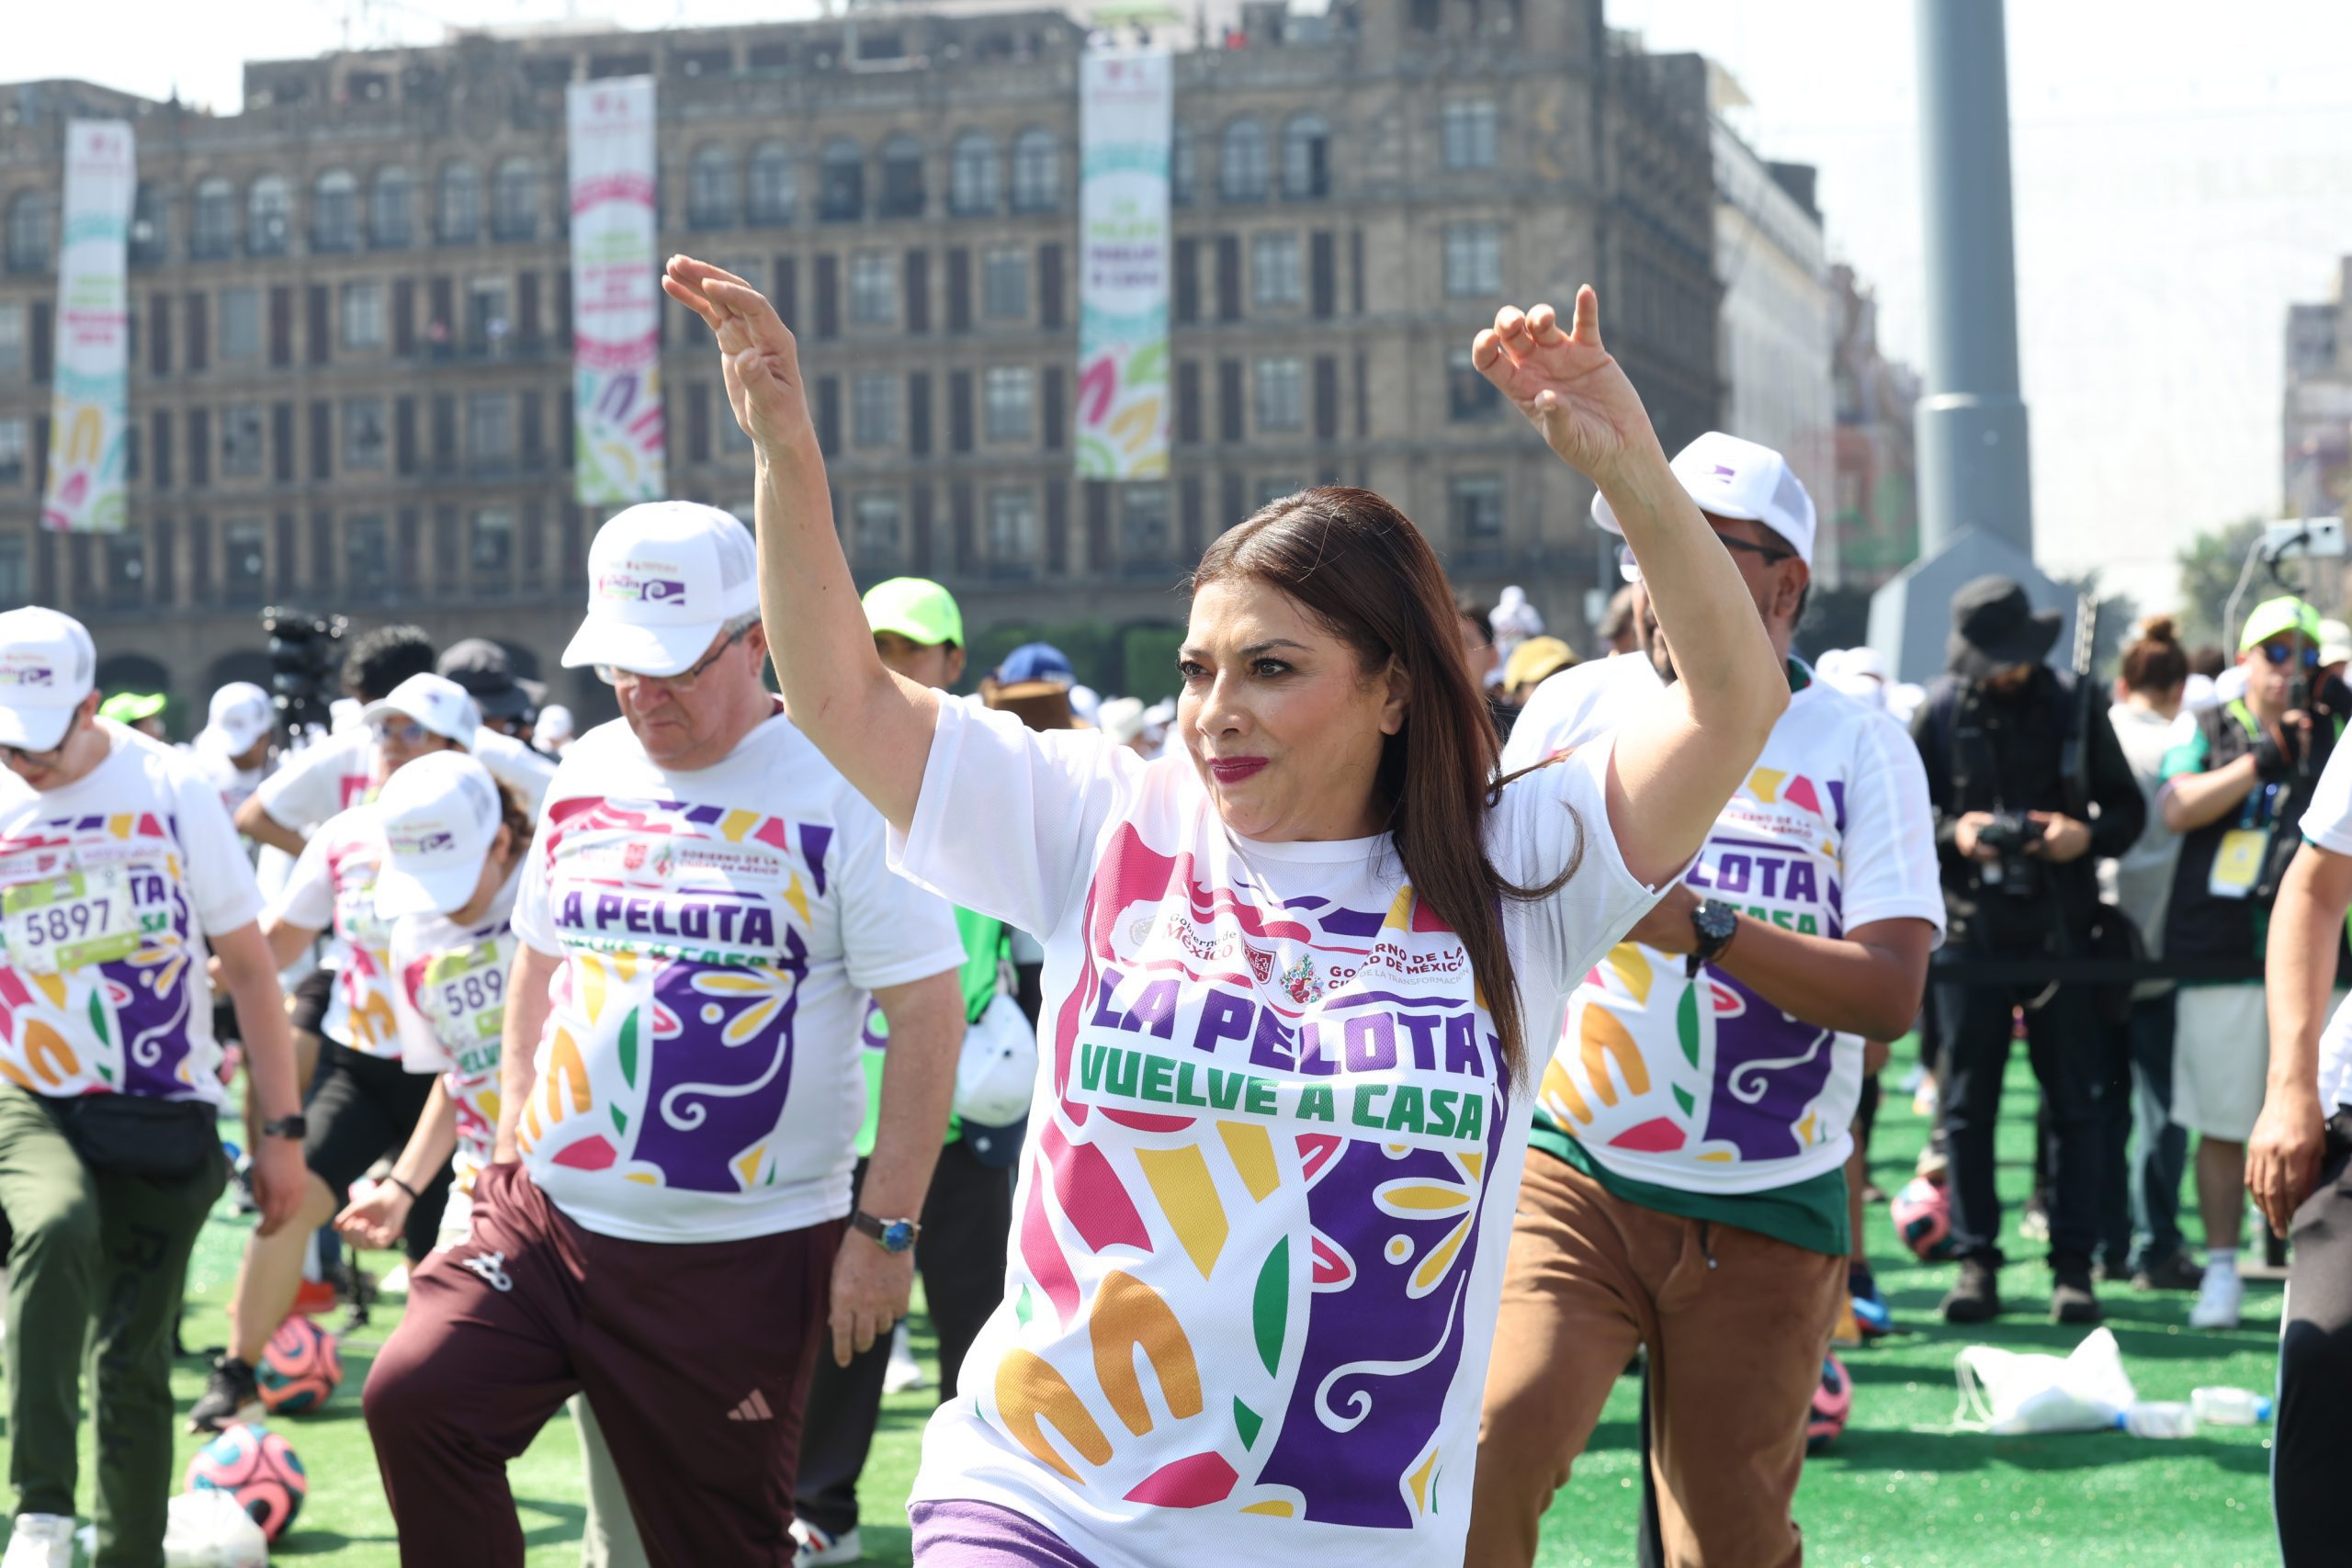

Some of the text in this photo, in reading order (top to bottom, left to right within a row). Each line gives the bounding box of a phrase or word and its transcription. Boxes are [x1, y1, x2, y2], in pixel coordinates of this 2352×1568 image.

[26, 898, 110, 946] 5897
[555, 891, 775, 947] A PELOTA
[1170, 912, 1237, 948] Gobierno de
[1162, 922, 1234, 961] México
[1329, 943, 1463, 977] GORNO DE LA
[1385, 956, 1403, 973] DE
[1406, 955, 1464, 975] MÉXICO
[1387, 967, 1469, 986] TRANSFORMACIÓN
[1091, 967, 1485, 1077] LA PELOTA
[1081, 1043, 1483, 1141] VUELVE A CASA
